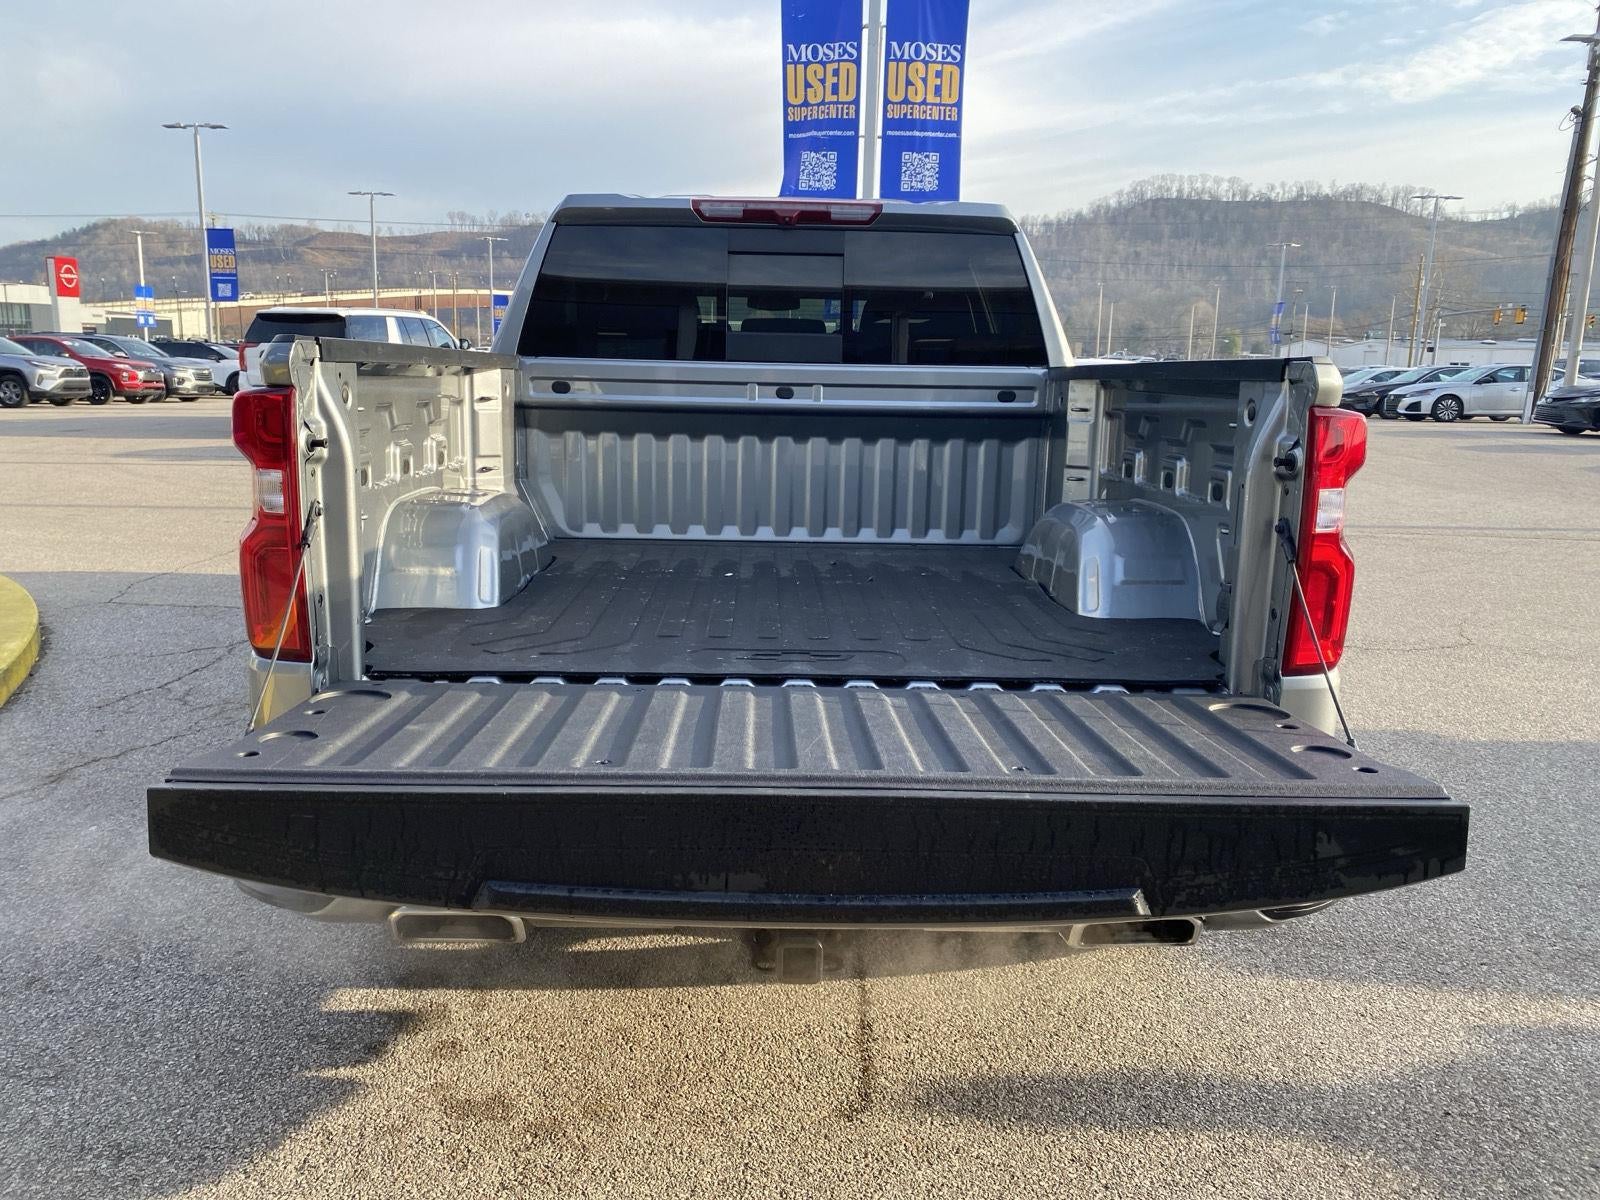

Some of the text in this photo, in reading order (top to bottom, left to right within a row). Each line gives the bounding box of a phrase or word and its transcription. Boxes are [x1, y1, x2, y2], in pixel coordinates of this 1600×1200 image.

[787, 42, 857, 61] MOSES
[890, 41, 961, 62] MOSES
[786, 62, 857, 105] USED
[887, 61, 960, 104] USED
[787, 105, 856, 122] SUPERCENTER
[887, 104, 957, 121] SUPERCENTER
[210, 254, 236, 268] USED
